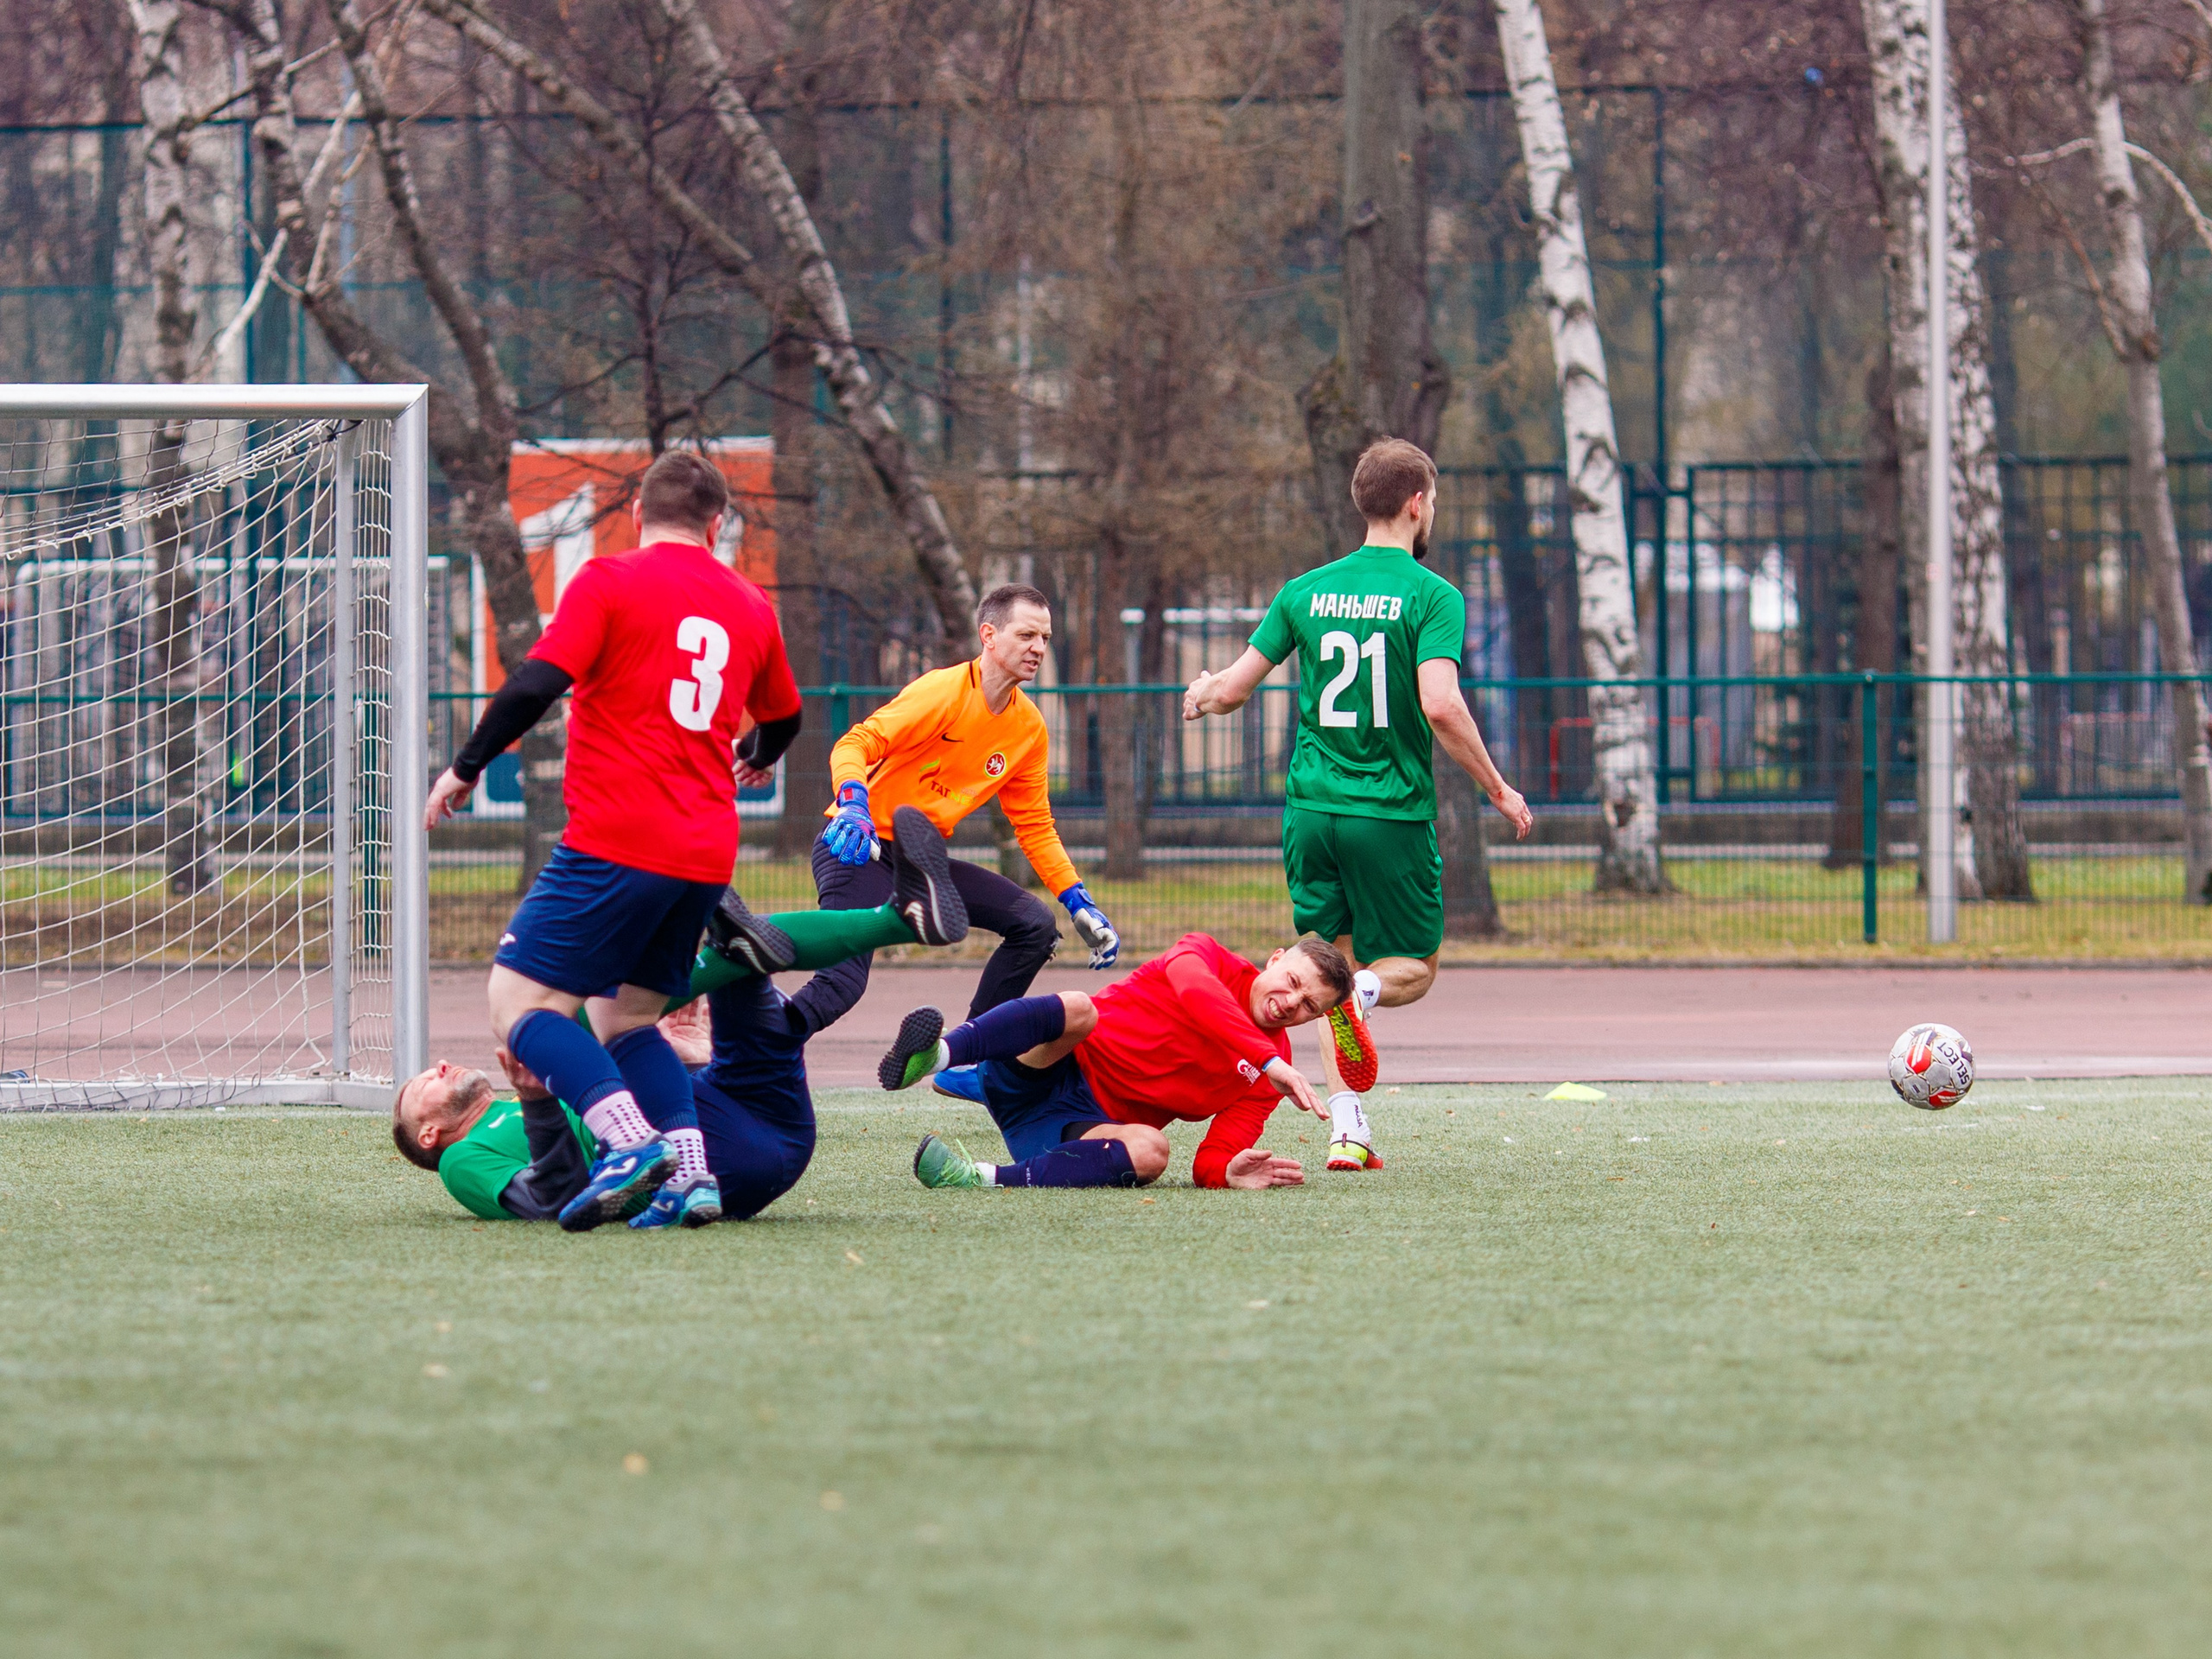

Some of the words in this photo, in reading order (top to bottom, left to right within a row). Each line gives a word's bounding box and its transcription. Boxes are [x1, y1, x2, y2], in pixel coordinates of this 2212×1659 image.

[1309, 593, 1402, 620] МАНЬШЕВ
[669, 616, 730, 731] 3
[1319, 630, 1389, 728] 21
[1936, 1042, 1970, 1084] SELECT
